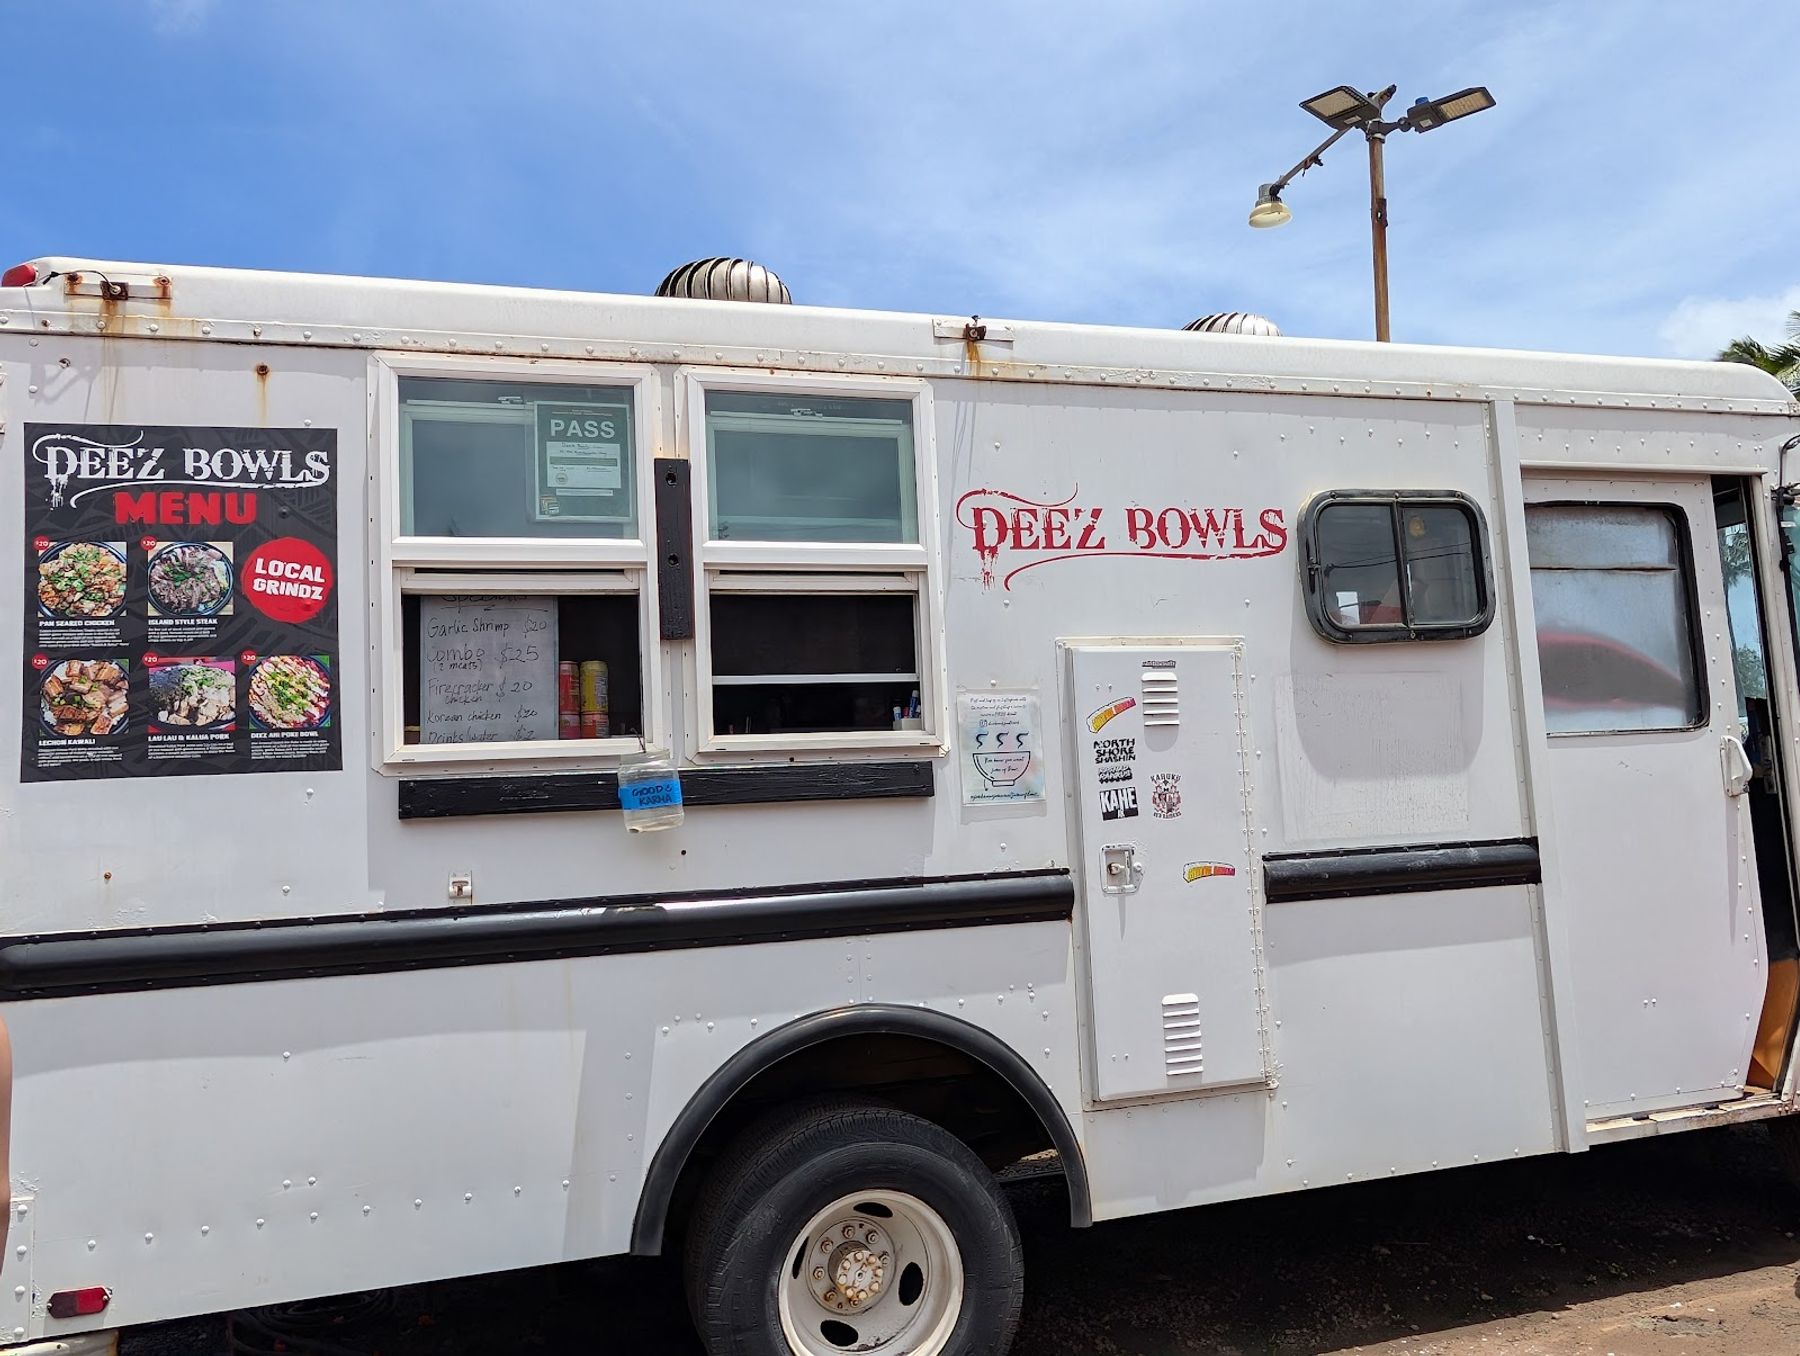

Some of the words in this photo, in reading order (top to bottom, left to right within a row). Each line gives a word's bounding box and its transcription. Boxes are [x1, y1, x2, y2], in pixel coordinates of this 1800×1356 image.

[550, 418, 616, 438] PASS
[183, 447, 330, 486] BOWLS
[113, 491, 257, 525] MENU
[1125, 507, 1288, 555] BOWLS
[255, 557, 325, 583] LOCAL
[252, 577, 324, 600] GRINDZ
[427, 617, 469, 638] Garlic
[473, 617, 511, 638] Shrimp
[522, 613, 547, 638] $20
[427, 642, 486, 663] Combo
[498, 640, 540, 669] $25
[428, 677, 494, 698] Firecracker
[467, 708, 502, 721] chicken
[1093, 738, 1136, 750] NORTH
[1096, 746, 1135, 758] SHORE
[632, 785, 664, 797] GOOD
[639, 795, 673, 807] KARMA
